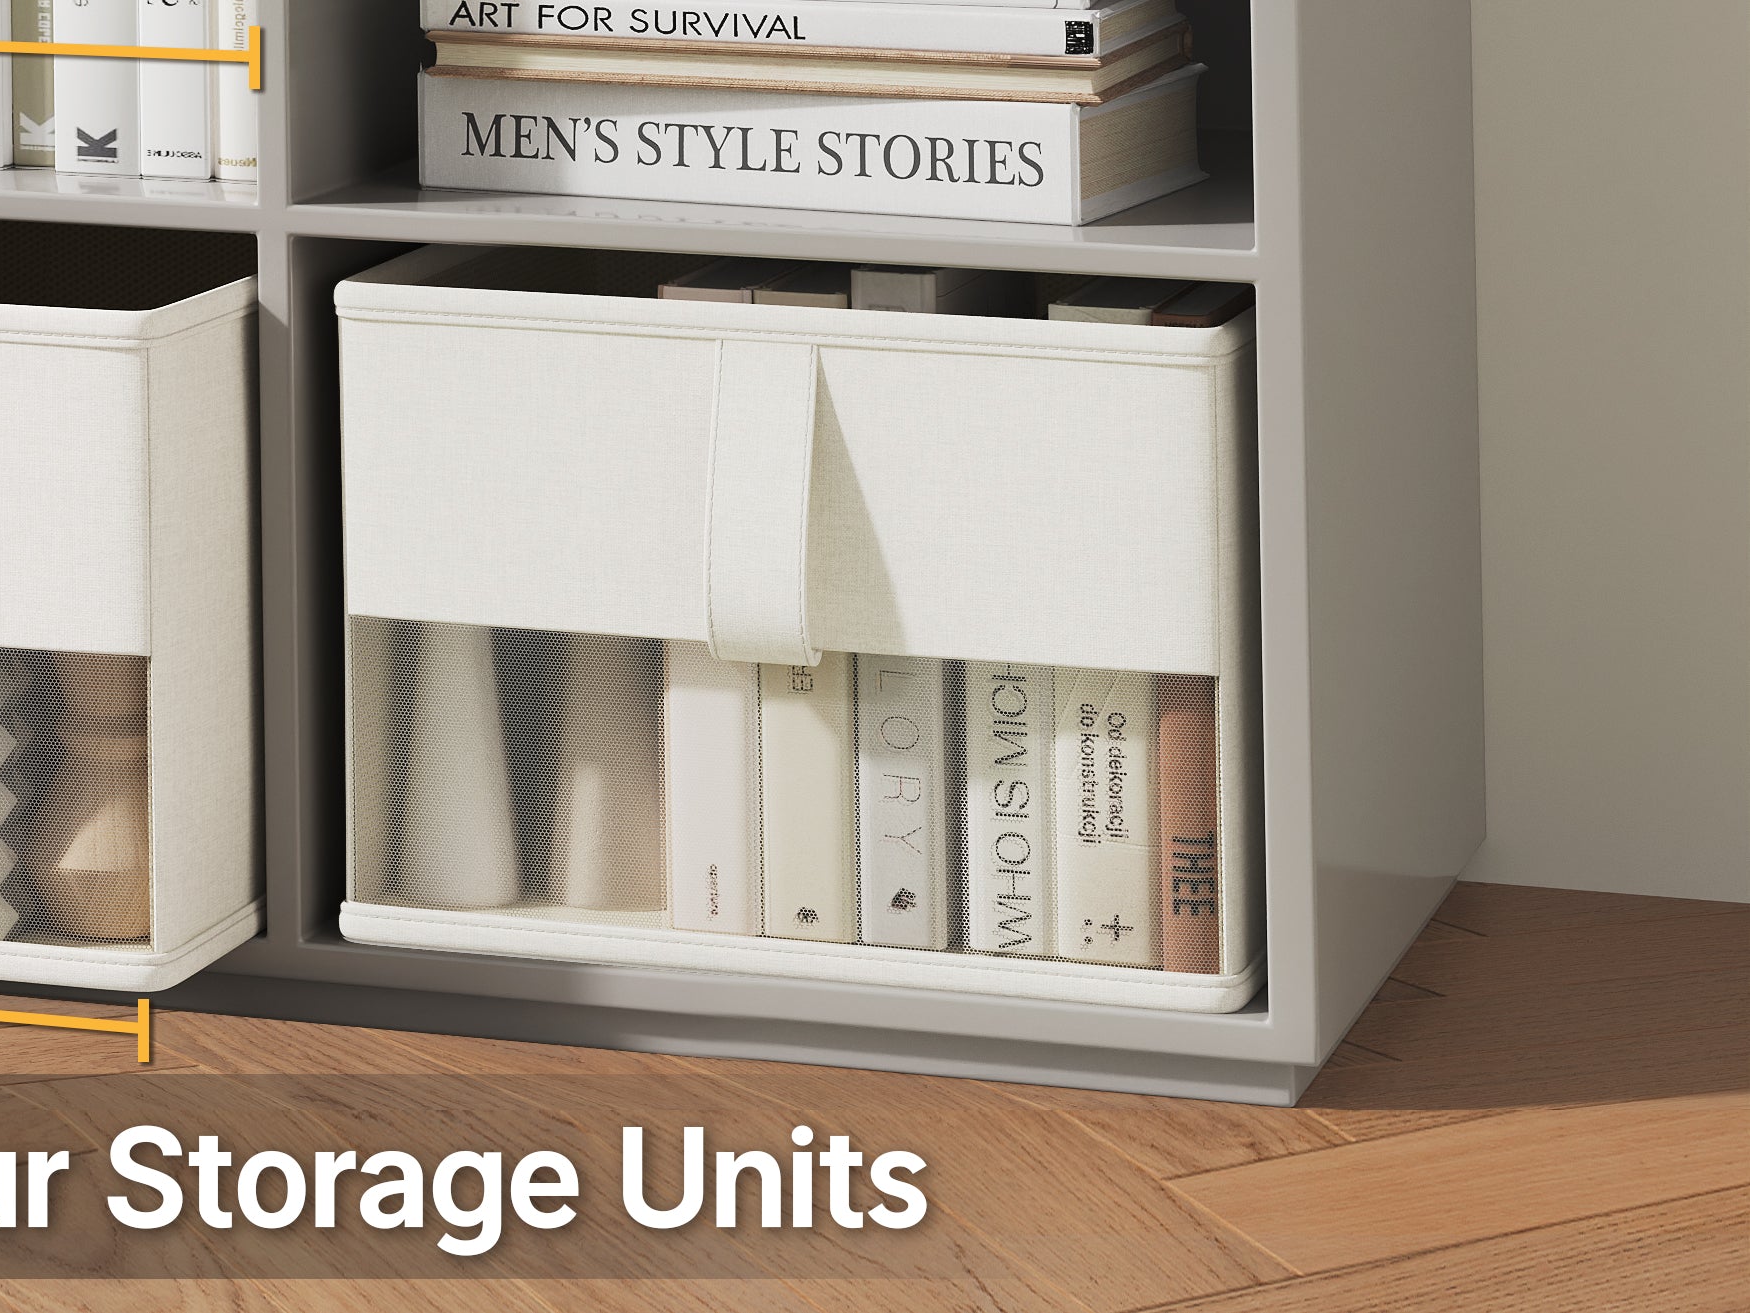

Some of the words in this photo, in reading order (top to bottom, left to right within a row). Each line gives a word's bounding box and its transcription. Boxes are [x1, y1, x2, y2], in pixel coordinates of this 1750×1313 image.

[449, 1, 520, 28] ART
[538, 4, 613, 33] FOR
[631, 8, 807, 41] SURVIVAL
[636, 121, 801, 175] STYLE
[817, 130, 1046, 188] STORIES
[1079, 703, 1099, 731] do
[1107, 712, 1127, 741] Od
[993, 780, 1030, 818] IS
[1078, 733, 1101, 844] konstrukcji
[1105, 745, 1129, 839] dekoracji
[995, 831, 1032, 950] WHO
